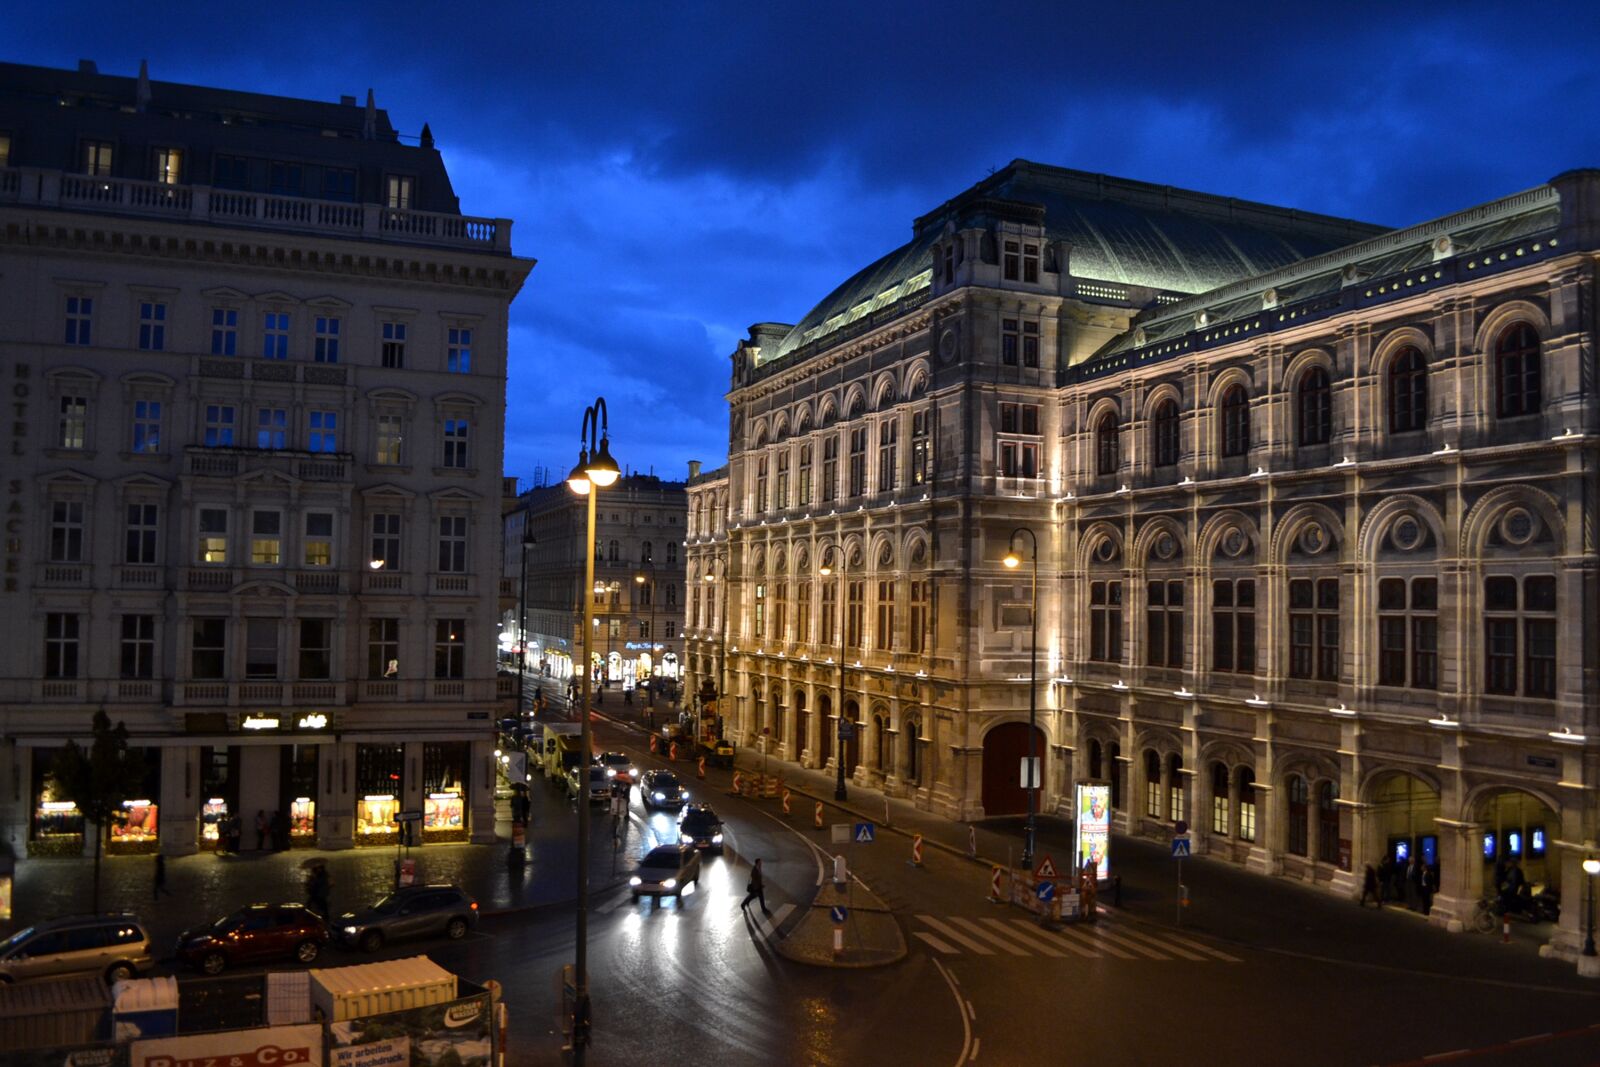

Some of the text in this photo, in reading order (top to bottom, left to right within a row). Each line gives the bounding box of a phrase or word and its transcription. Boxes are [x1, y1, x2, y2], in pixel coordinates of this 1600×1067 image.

[5, 364, 30, 592] HOTEL SACHER
[338, 1045, 393, 1060] Wir arbeiten
[229, 1057, 243, 1067] &
